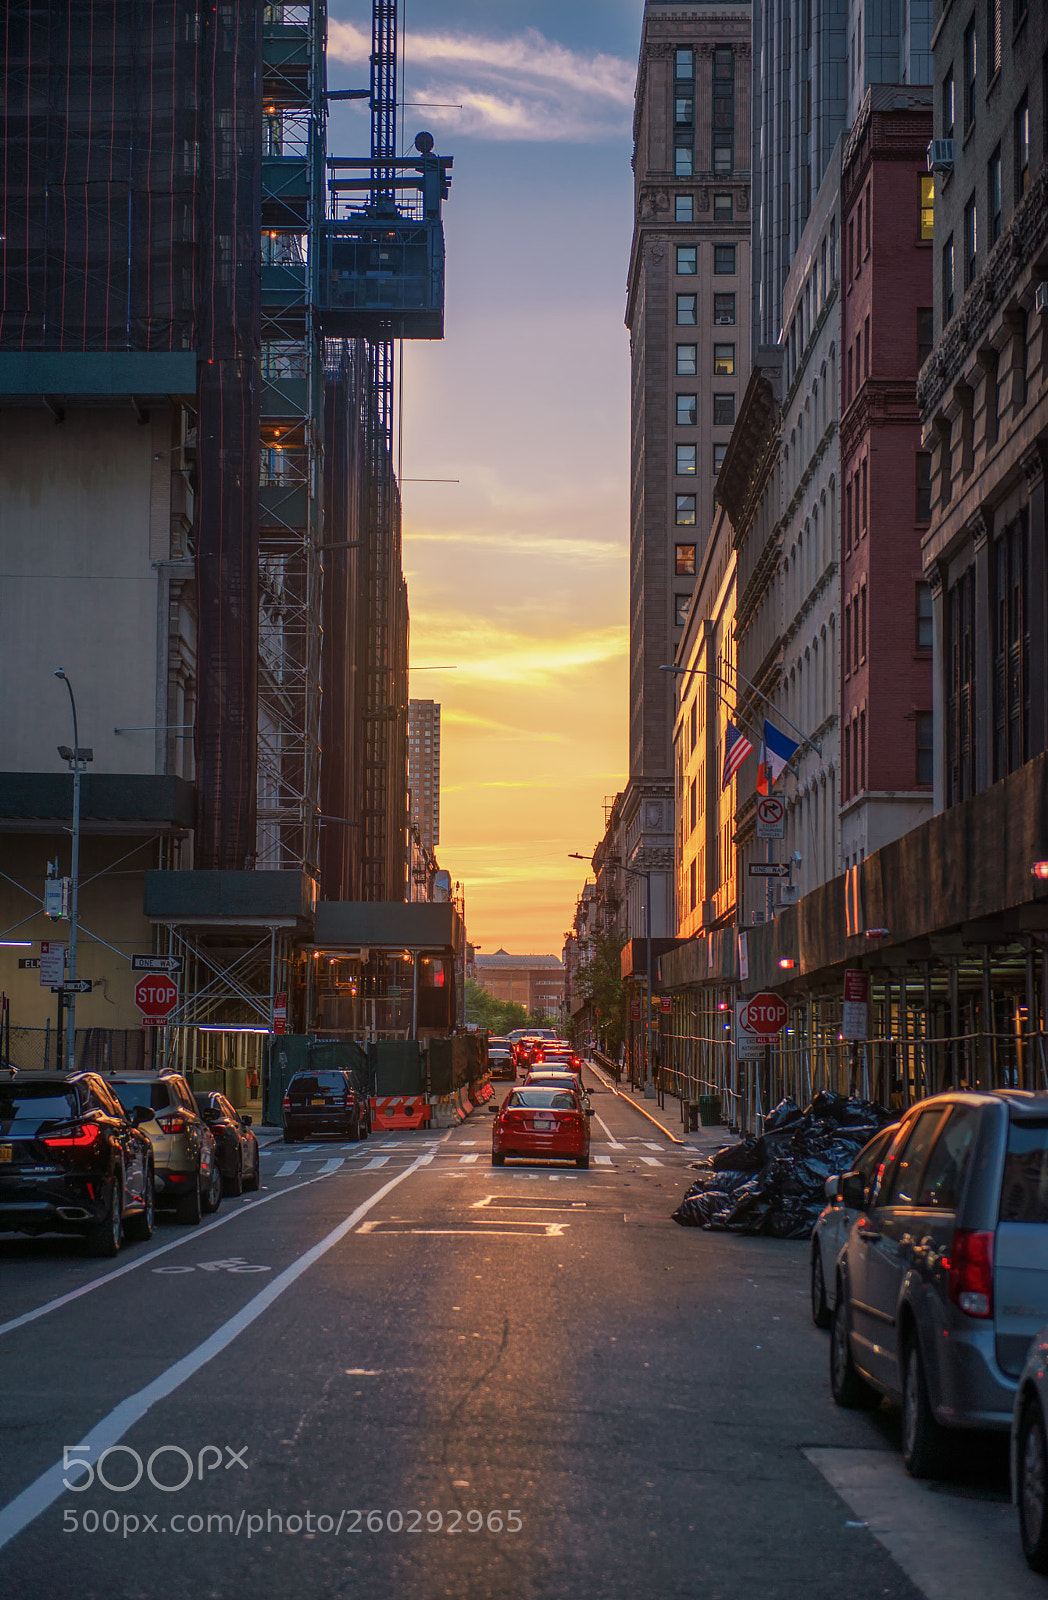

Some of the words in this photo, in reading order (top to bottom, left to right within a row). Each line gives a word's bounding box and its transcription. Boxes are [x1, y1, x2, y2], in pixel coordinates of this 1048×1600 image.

[139, 959, 154, 967] ONE
[160, 960, 175, 968] WAY
[138, 987, 176, 1003] STOP
[749, 1006, 785, 1021] STOP
